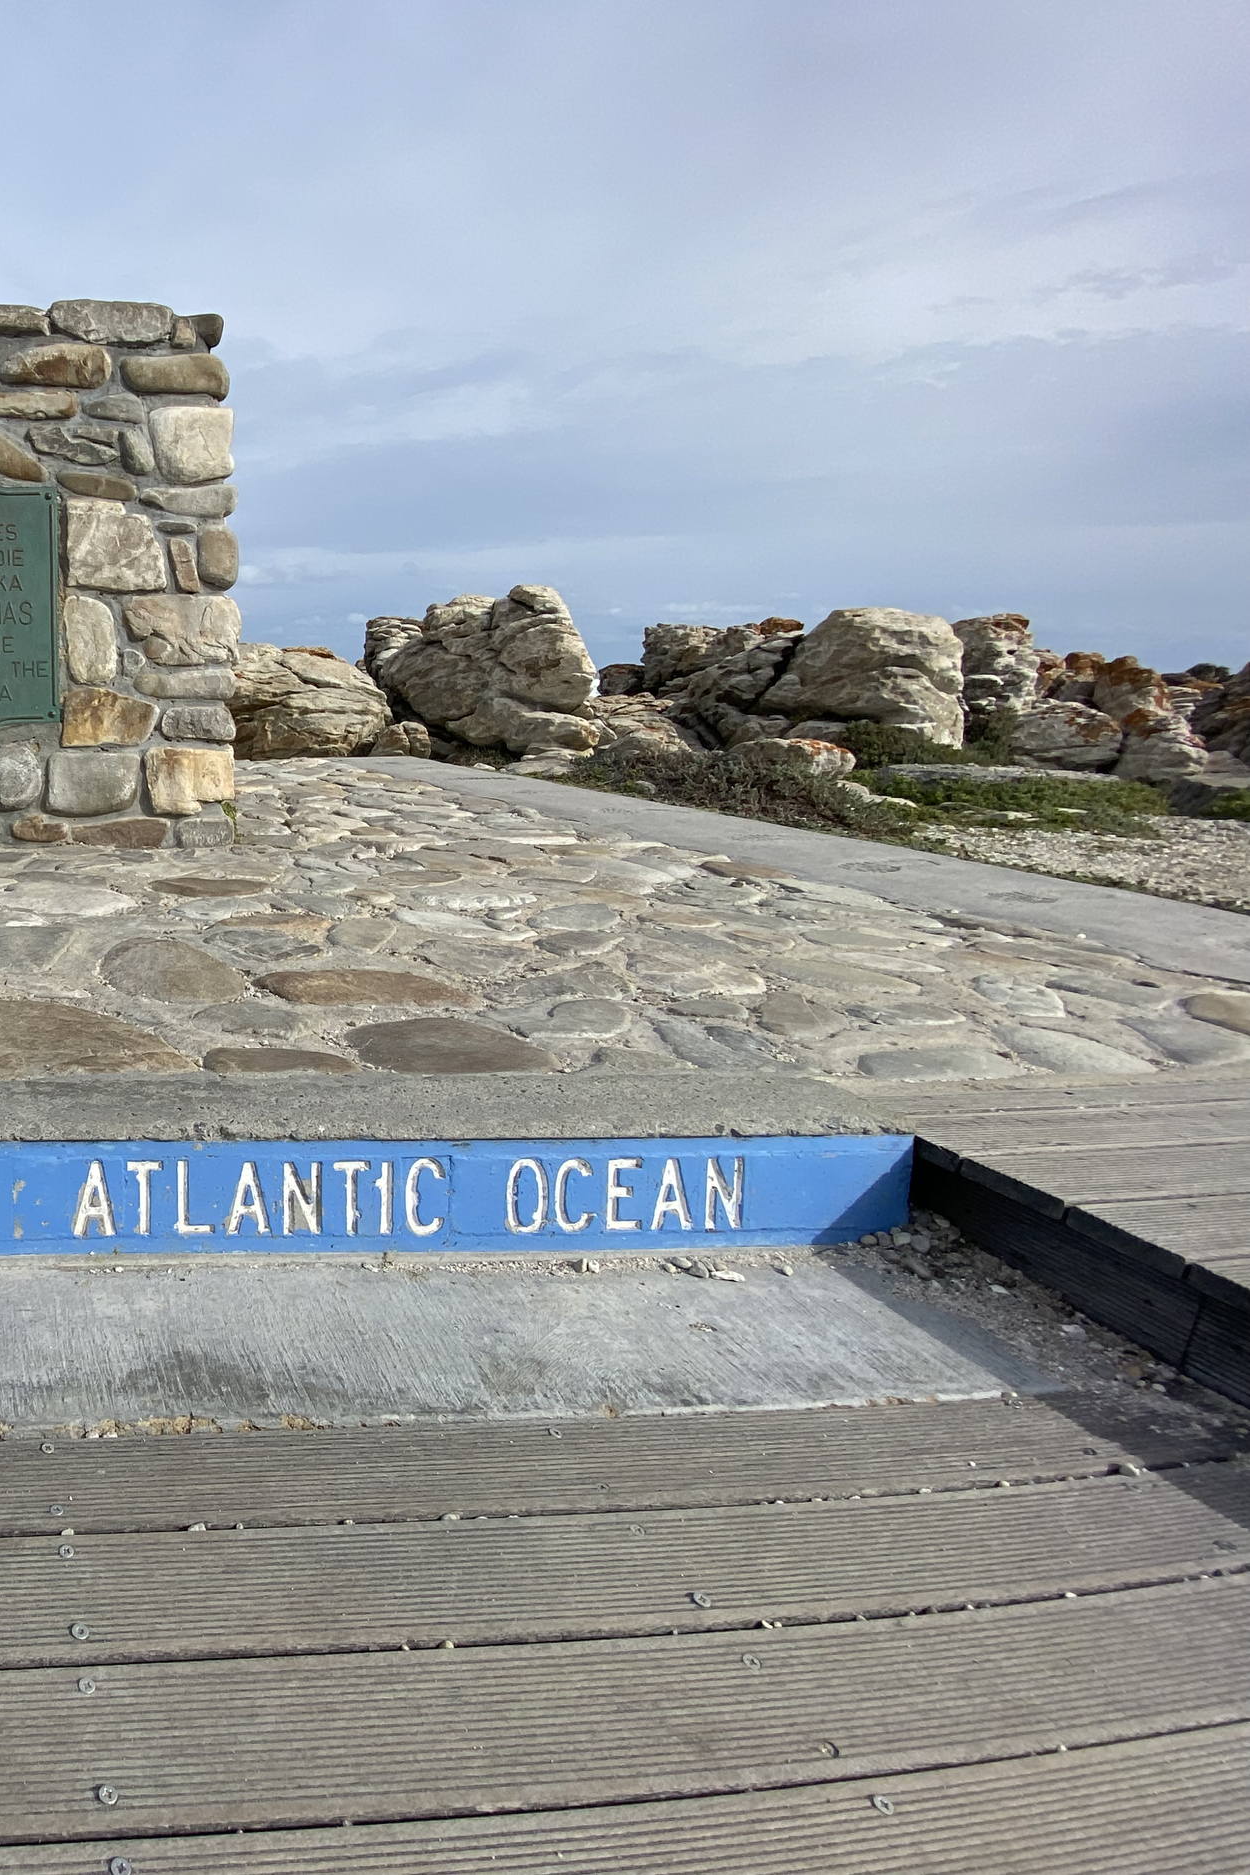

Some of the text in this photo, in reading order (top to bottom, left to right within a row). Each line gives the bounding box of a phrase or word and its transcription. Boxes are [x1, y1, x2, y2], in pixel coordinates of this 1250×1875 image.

[11, 661, 49, 678] THE
[72, 1156, 744, 1238] ATLANTIC OCEAN
